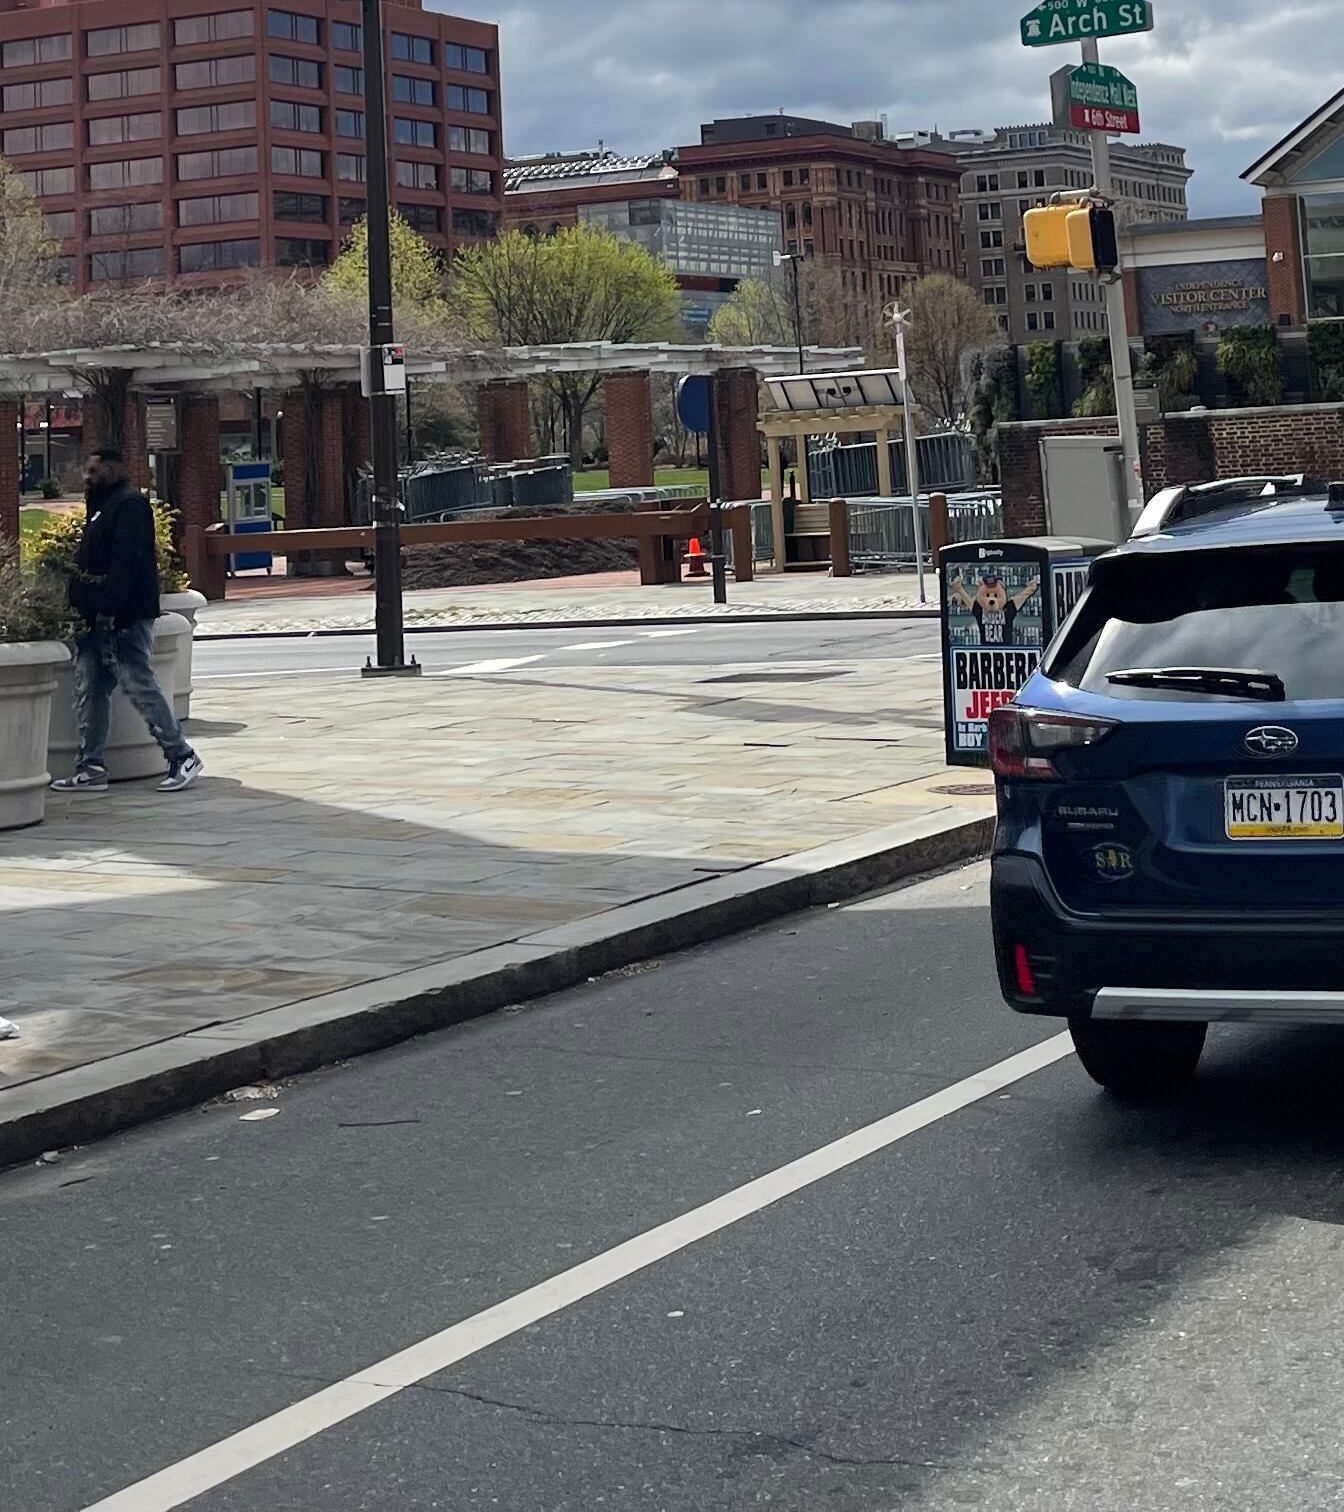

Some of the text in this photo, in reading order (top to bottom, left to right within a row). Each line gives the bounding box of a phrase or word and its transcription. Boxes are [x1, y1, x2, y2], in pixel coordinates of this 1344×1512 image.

[1047, 0, 1069, 11] 500
[1049, 4, 1143, 38] Arch St
[1091, 109, 1128, 129] 6th Street
[1151, 288, 1267, 305] VISITOR CENTER
[1255, 778, 1315, 788] PENNSYLVANIA
[1058, 805, 1119, 817] SUBARU
